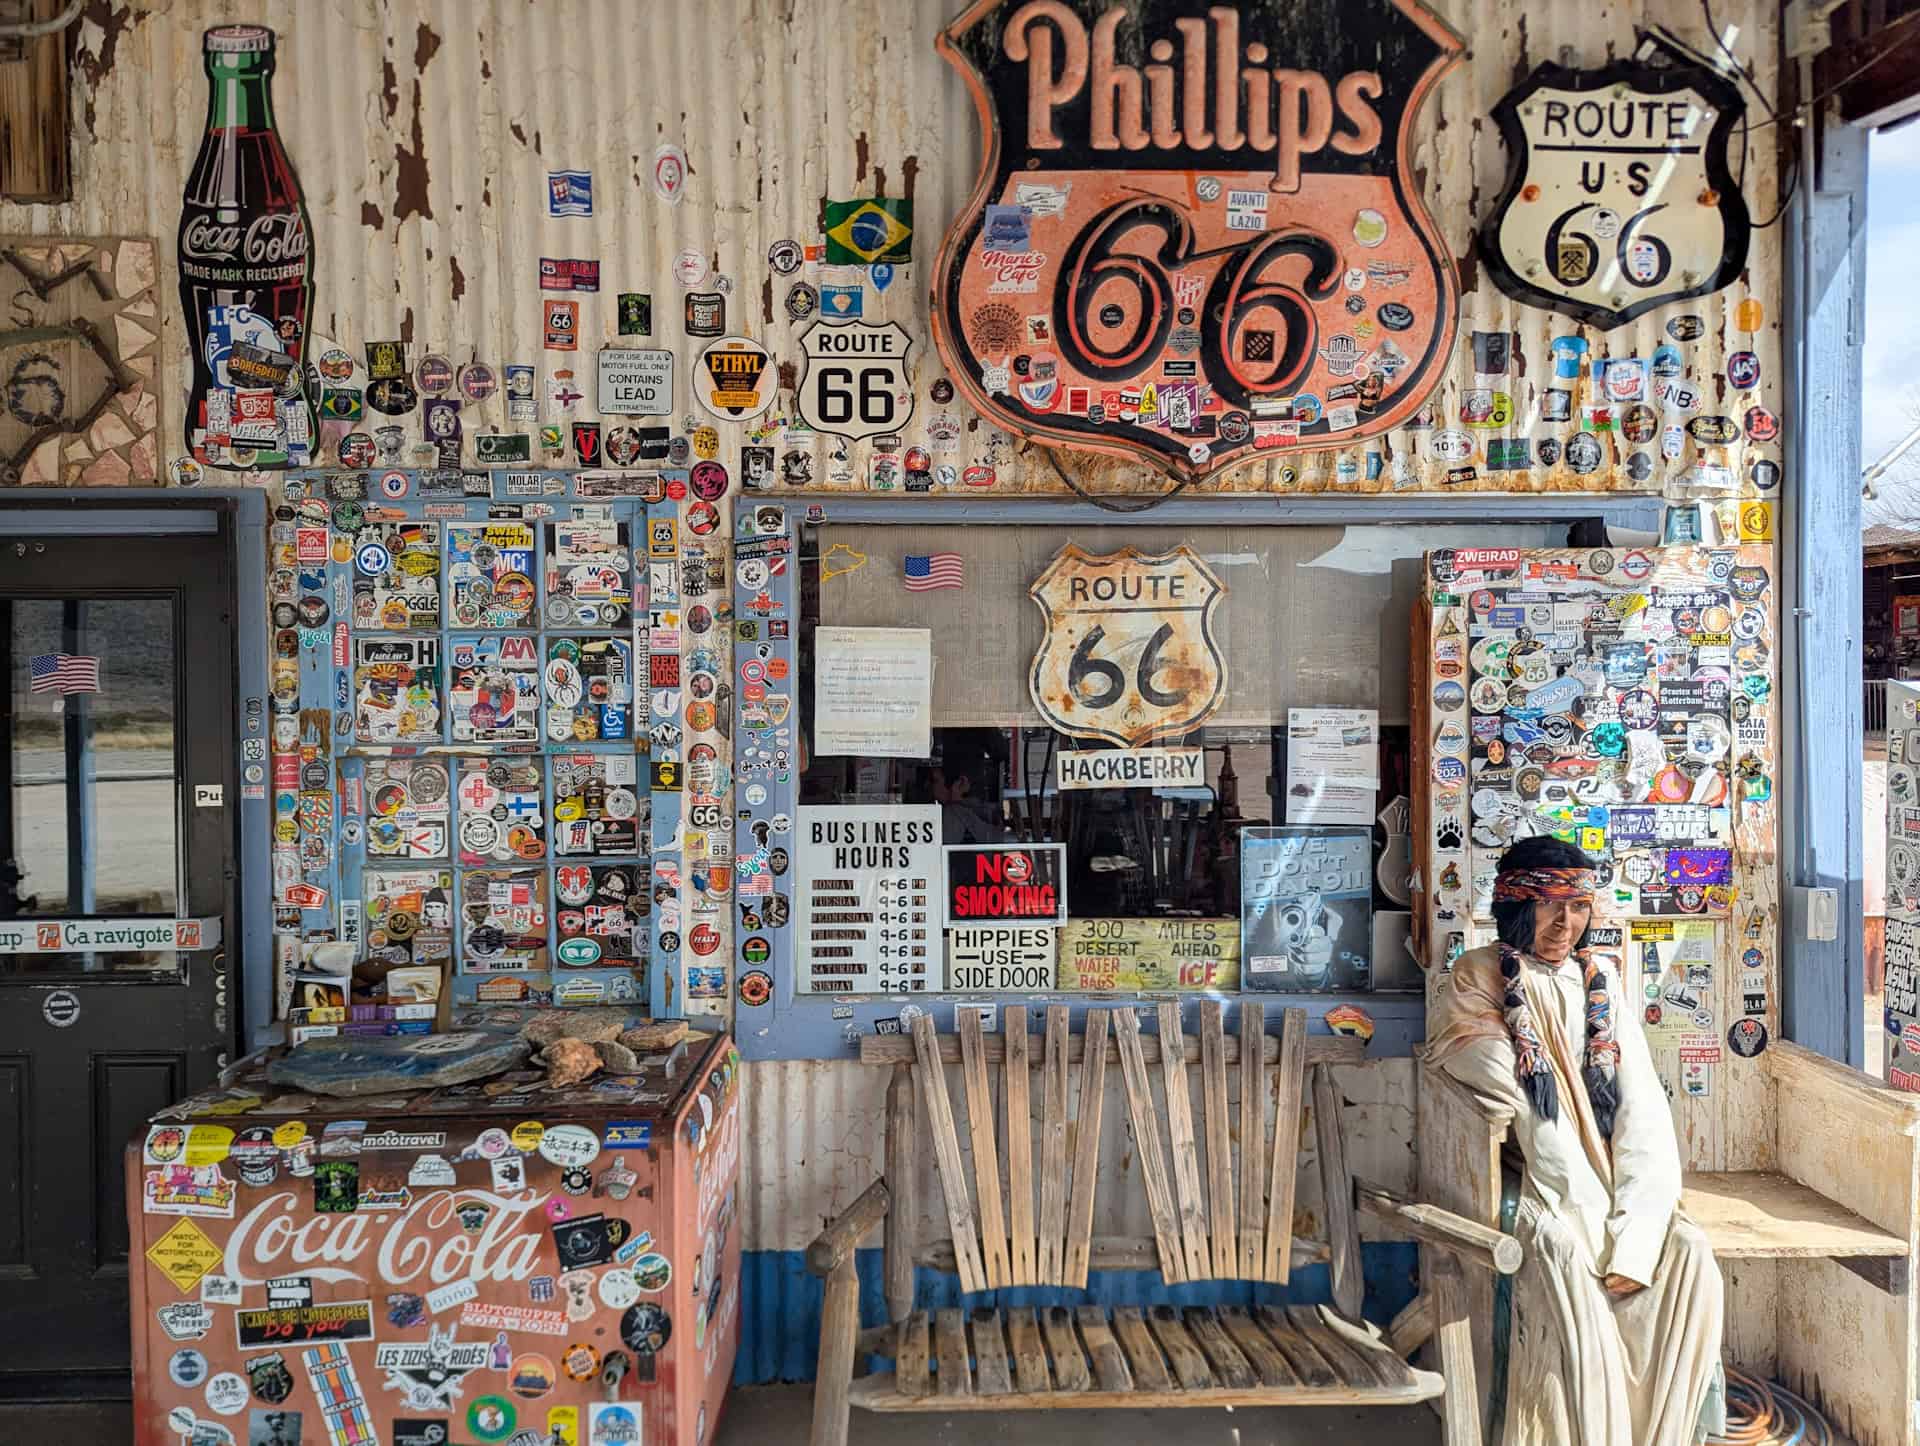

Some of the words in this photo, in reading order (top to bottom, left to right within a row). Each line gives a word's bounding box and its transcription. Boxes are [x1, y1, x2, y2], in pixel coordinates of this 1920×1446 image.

[1003, 4, 1383, 193] Phillips
[1543, 101, 1689, 139] ROUTE
[1544, 202, 1672, 288] 66
[981, 250, 1046, 268] Marie's
[183, 262, 210, 279] TRADE
[212, 267, 245, 281] MARK
[246, 263, 306, 280] REGISTERED
[1053, 197, 1344, 408] 66
[551, 314, 571, 327] 66
[818, 334, 893, 352] ROUTE
[711, 354, 762, 373] ETHYL
[608, 374, 663, 386] CONTAINS
[615, 387, 656, 401] LEAD
[818, 367, 895, 424] 66
[508, 475, 539, 486] MOLAR
[654, 529, 671, 540] 66
[1456, 550, 1519, 563] ZWEIRAD
[1069, 575, 1185, 602] ROUTE
[457, 653, 473, 664] 66
[651, 655, 679, 667] RED
[1068, 622, 1192, 709] 66
[651, 667, 679, 684] DOGS
[1739, 729, 1766, 739] ROBY
[1061, 754, 1199, 783] HACKBERRY
[1437, 768, 1463, 778] 2021
[1576, 779, 1600, 795] PJ
[693, 806, 719, 824] 66
[811, 821, 934, 844] BUSINESS
[712, 844, 729, 855] 66
[835, 847, 910, 869] HOURS
[1255, 855, 1348, 879] DON'T
[954, 885, 1056, 916] SMOKING
[95, 927, 174, 950] ravigote
[954, 928, 1050, 948] HIPPIES
[1081, 919, 1124, 939] 300
[1158, 920, 1217, 941] MILES
[982, 950, 1023, 965] USE
[1075, 941, 1139, 957] DESERT
[1171, 943, 1222, 957] AHEAD
[1075, 957, 1121, 975] WATER
[954, 967, 995, 989] SIDE
[1000, 967, 1050, 989] DOOR
[1080, 973, 1115, 990] BAGS
[1178, 962, 1218, 986] ICE
[362, 1133, 441, 1147] mototravel
[171, 1233, 199, 1241] WATCH
[223, 1188, 552, 1285] Coca-Cola
[156, 1249, 216, 1258] MOTORCYCLES
[378, 1349, 399, 1366] LES
